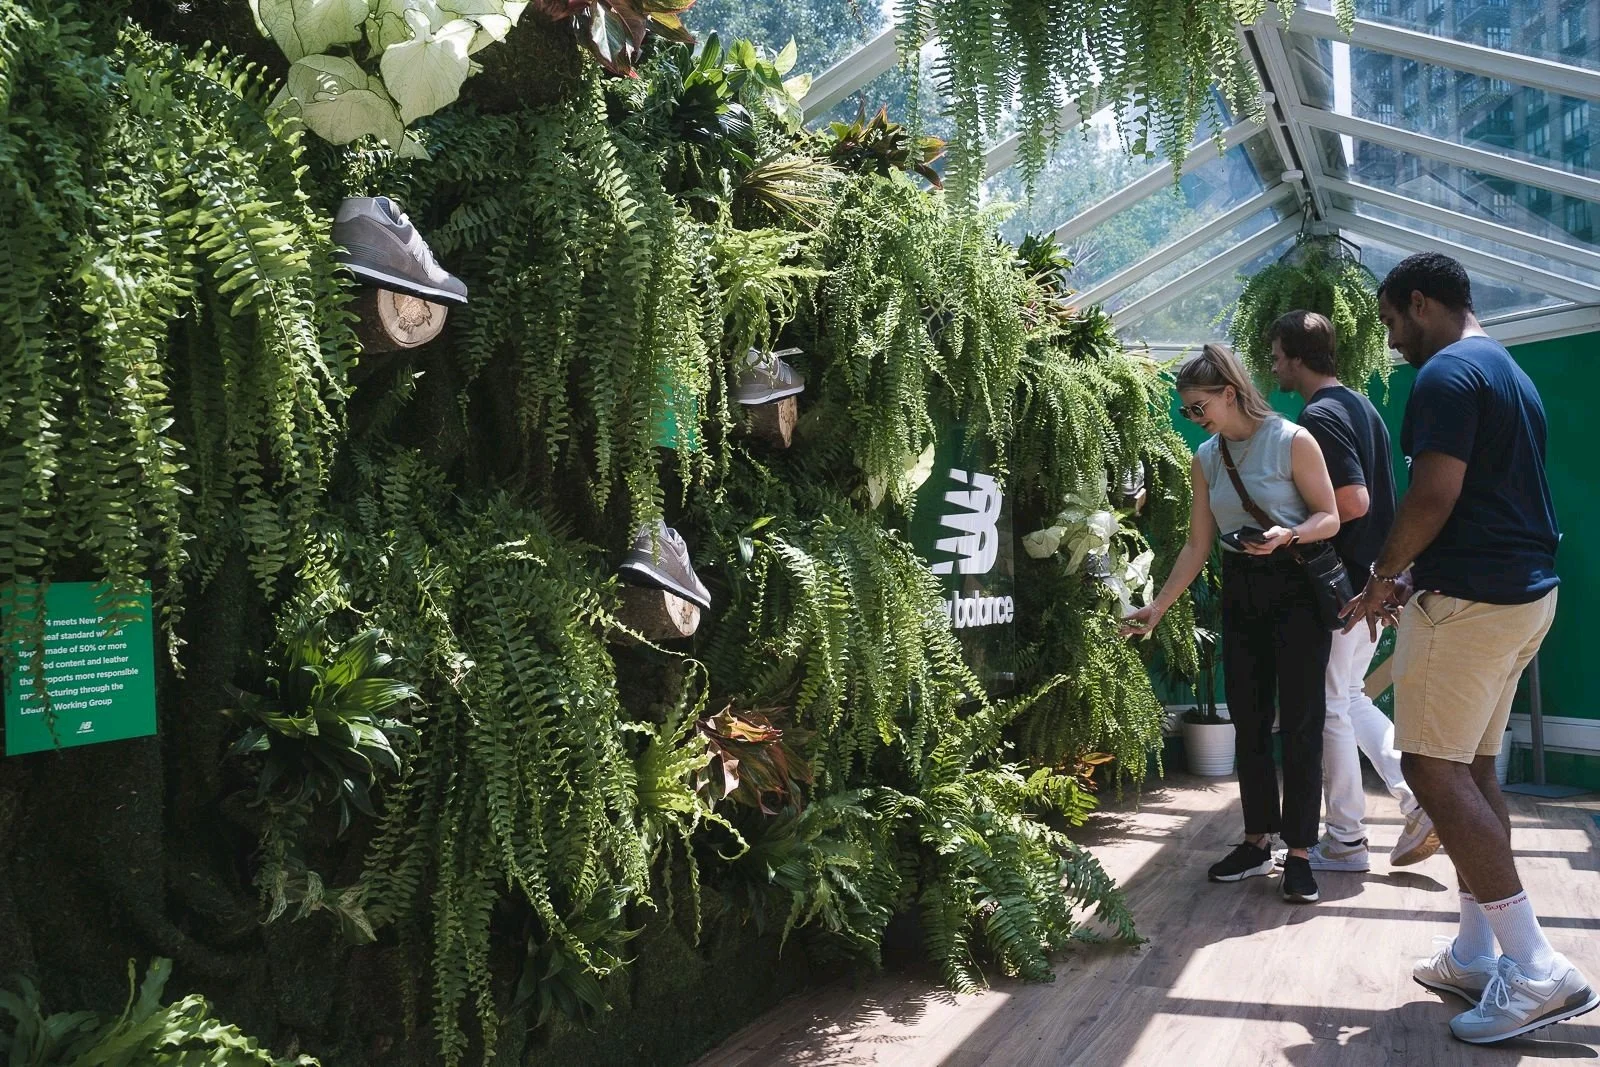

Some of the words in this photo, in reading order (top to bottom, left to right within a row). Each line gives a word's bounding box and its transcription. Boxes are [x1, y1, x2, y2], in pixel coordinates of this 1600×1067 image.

[953, 590, 1014, 629] balance
[79, 617, 96, 625] New
[61, 631, 94, 640] standard
[45, 648, 68, 656] made
[69, 645, 77, 653] of
[80, 644, 96, 653] 50%
[98, 644, 106, 652] or
[108, 642, 127, 651] more
[56, 659, 85, 669] content
[87, 657, 101, 666] and
[103, 656, 128, 665] leather
[75, 672, 95, 681] more
[97, 669, 139, 680] responsible
[80, 685, 110, 695] through
[111, 683, 124, 691] the
[54, 701, 87, 712] Working
[89, 698, 112, 709] Group
[1484, 895, 1527, 911] Supreme
